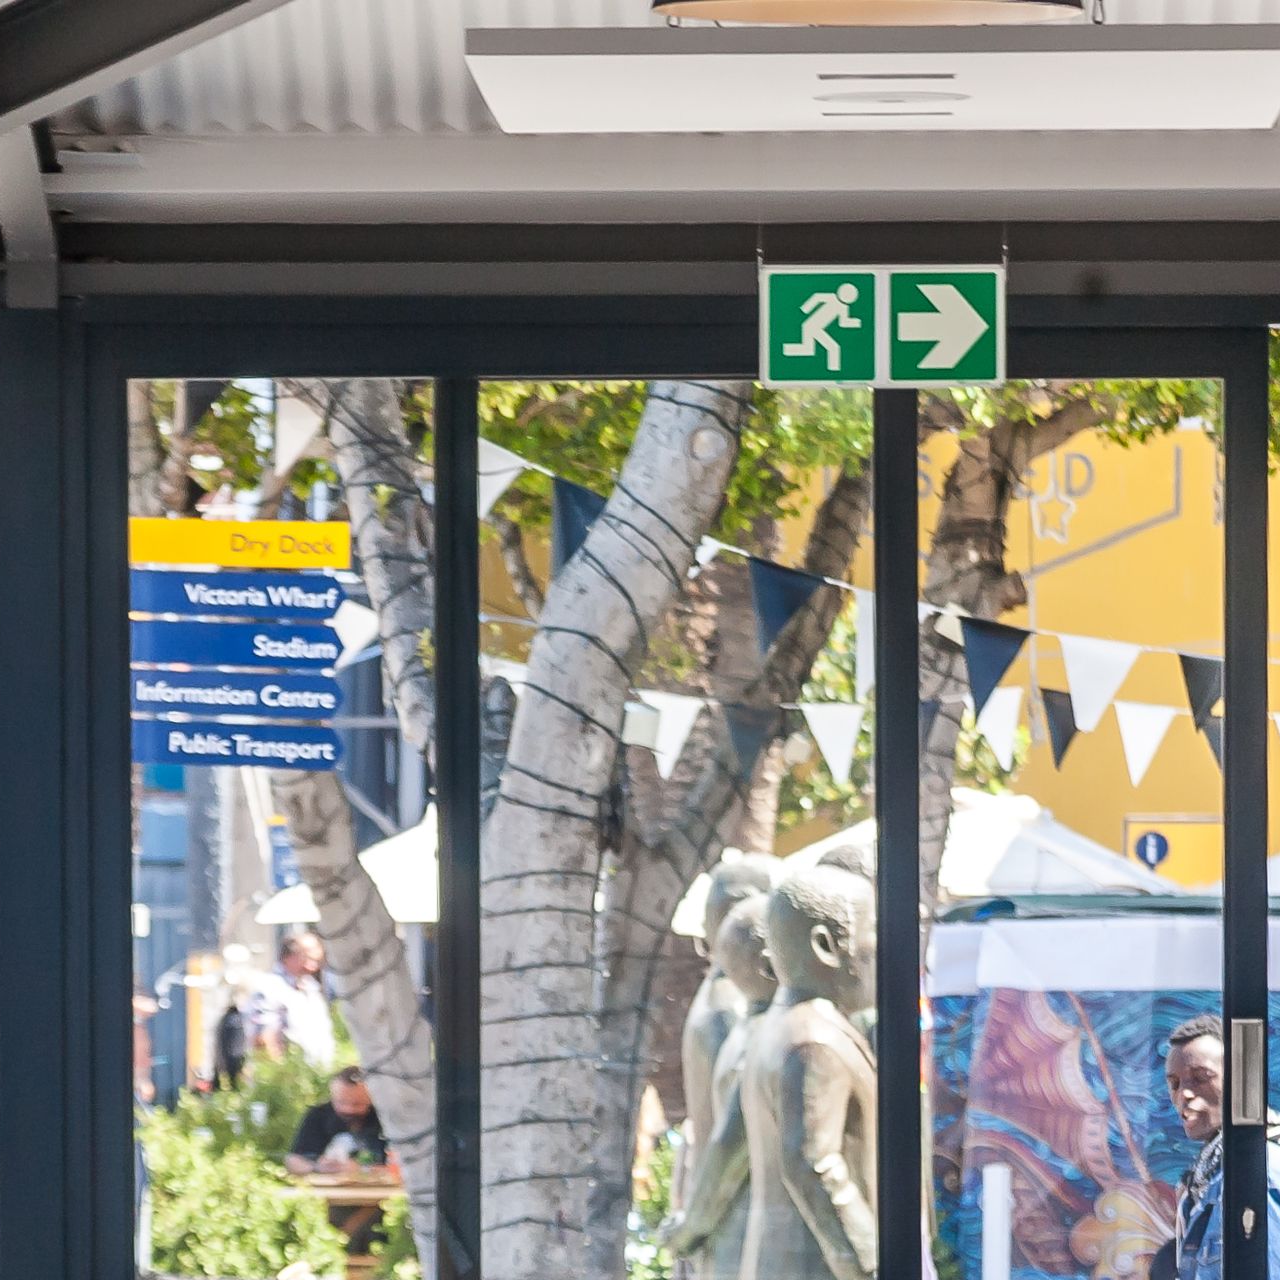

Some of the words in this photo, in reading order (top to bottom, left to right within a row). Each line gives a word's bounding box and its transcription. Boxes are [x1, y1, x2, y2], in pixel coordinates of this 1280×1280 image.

[230, 533, 269, 557] Dry
[279, 534, 336, 555] Dock
[184, 582, 267, 607] Victoria
[267, 585, 339, 609] Wharf
[253, 634, 338, 659] Stadium
[135, 680, 257, 706] Information
[260, 684, 336, 709] Centre
[168, 731, 232, 756] Public
[231, 734, 336, 763] Transport
